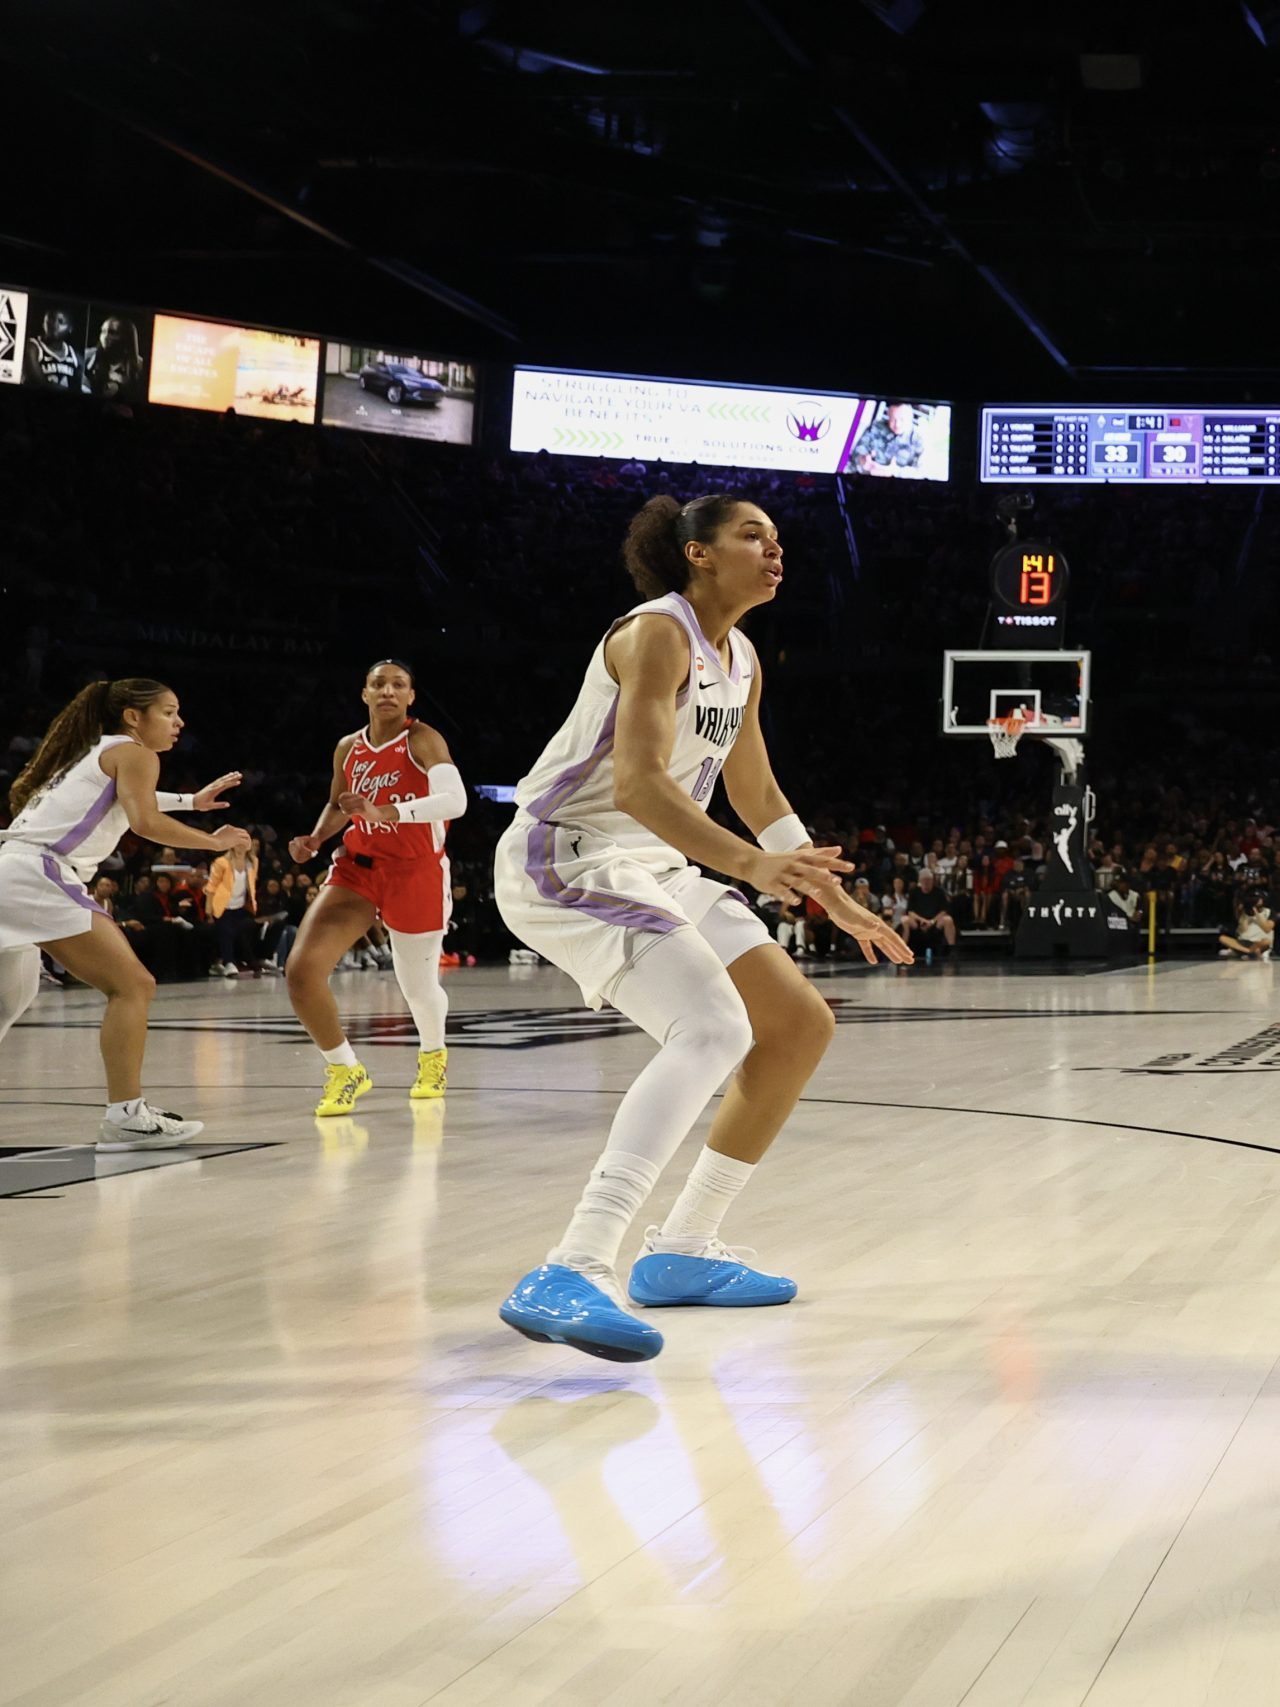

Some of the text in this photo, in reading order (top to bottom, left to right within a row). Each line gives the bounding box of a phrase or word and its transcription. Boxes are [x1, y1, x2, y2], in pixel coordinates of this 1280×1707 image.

[526, 390, 612, 406] NAVIGATE
[624, 398, 672, 411] YOUR
[1136, 416, 1162, 428] 1:41
[1105, 445, 1128, 462] 33
[1163, 445, 1187, 462] 30
[1020, 572, 1051, 604] 13
[138, 625, 328, 655] MANDALAY BAY
[351, 761, 402, 804] Vegas
[1053, 804, 1078, 817] ally
